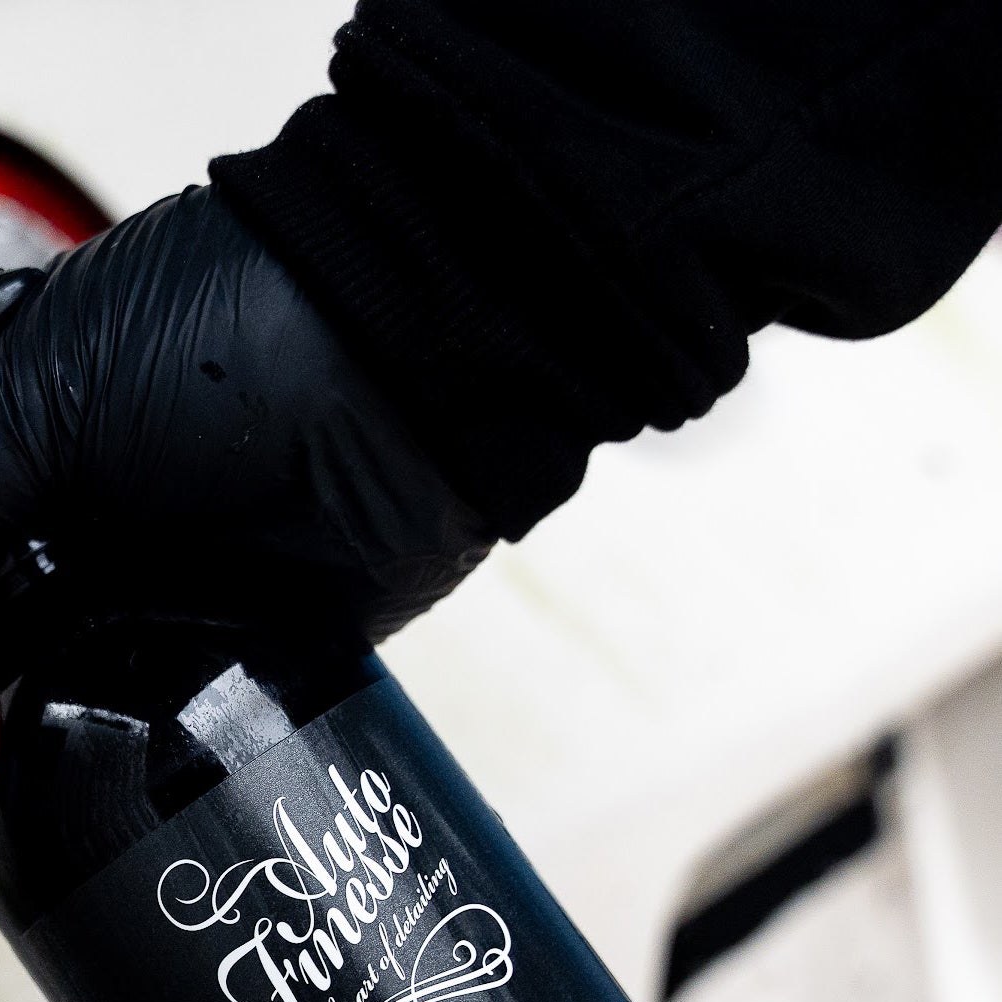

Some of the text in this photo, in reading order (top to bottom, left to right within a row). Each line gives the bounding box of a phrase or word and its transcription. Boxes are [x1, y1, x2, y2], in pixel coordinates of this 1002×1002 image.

[158, 764, 392, 944] Auto
[379, 922, 406, 981] of
[393, 857, 458, 948] detailing
